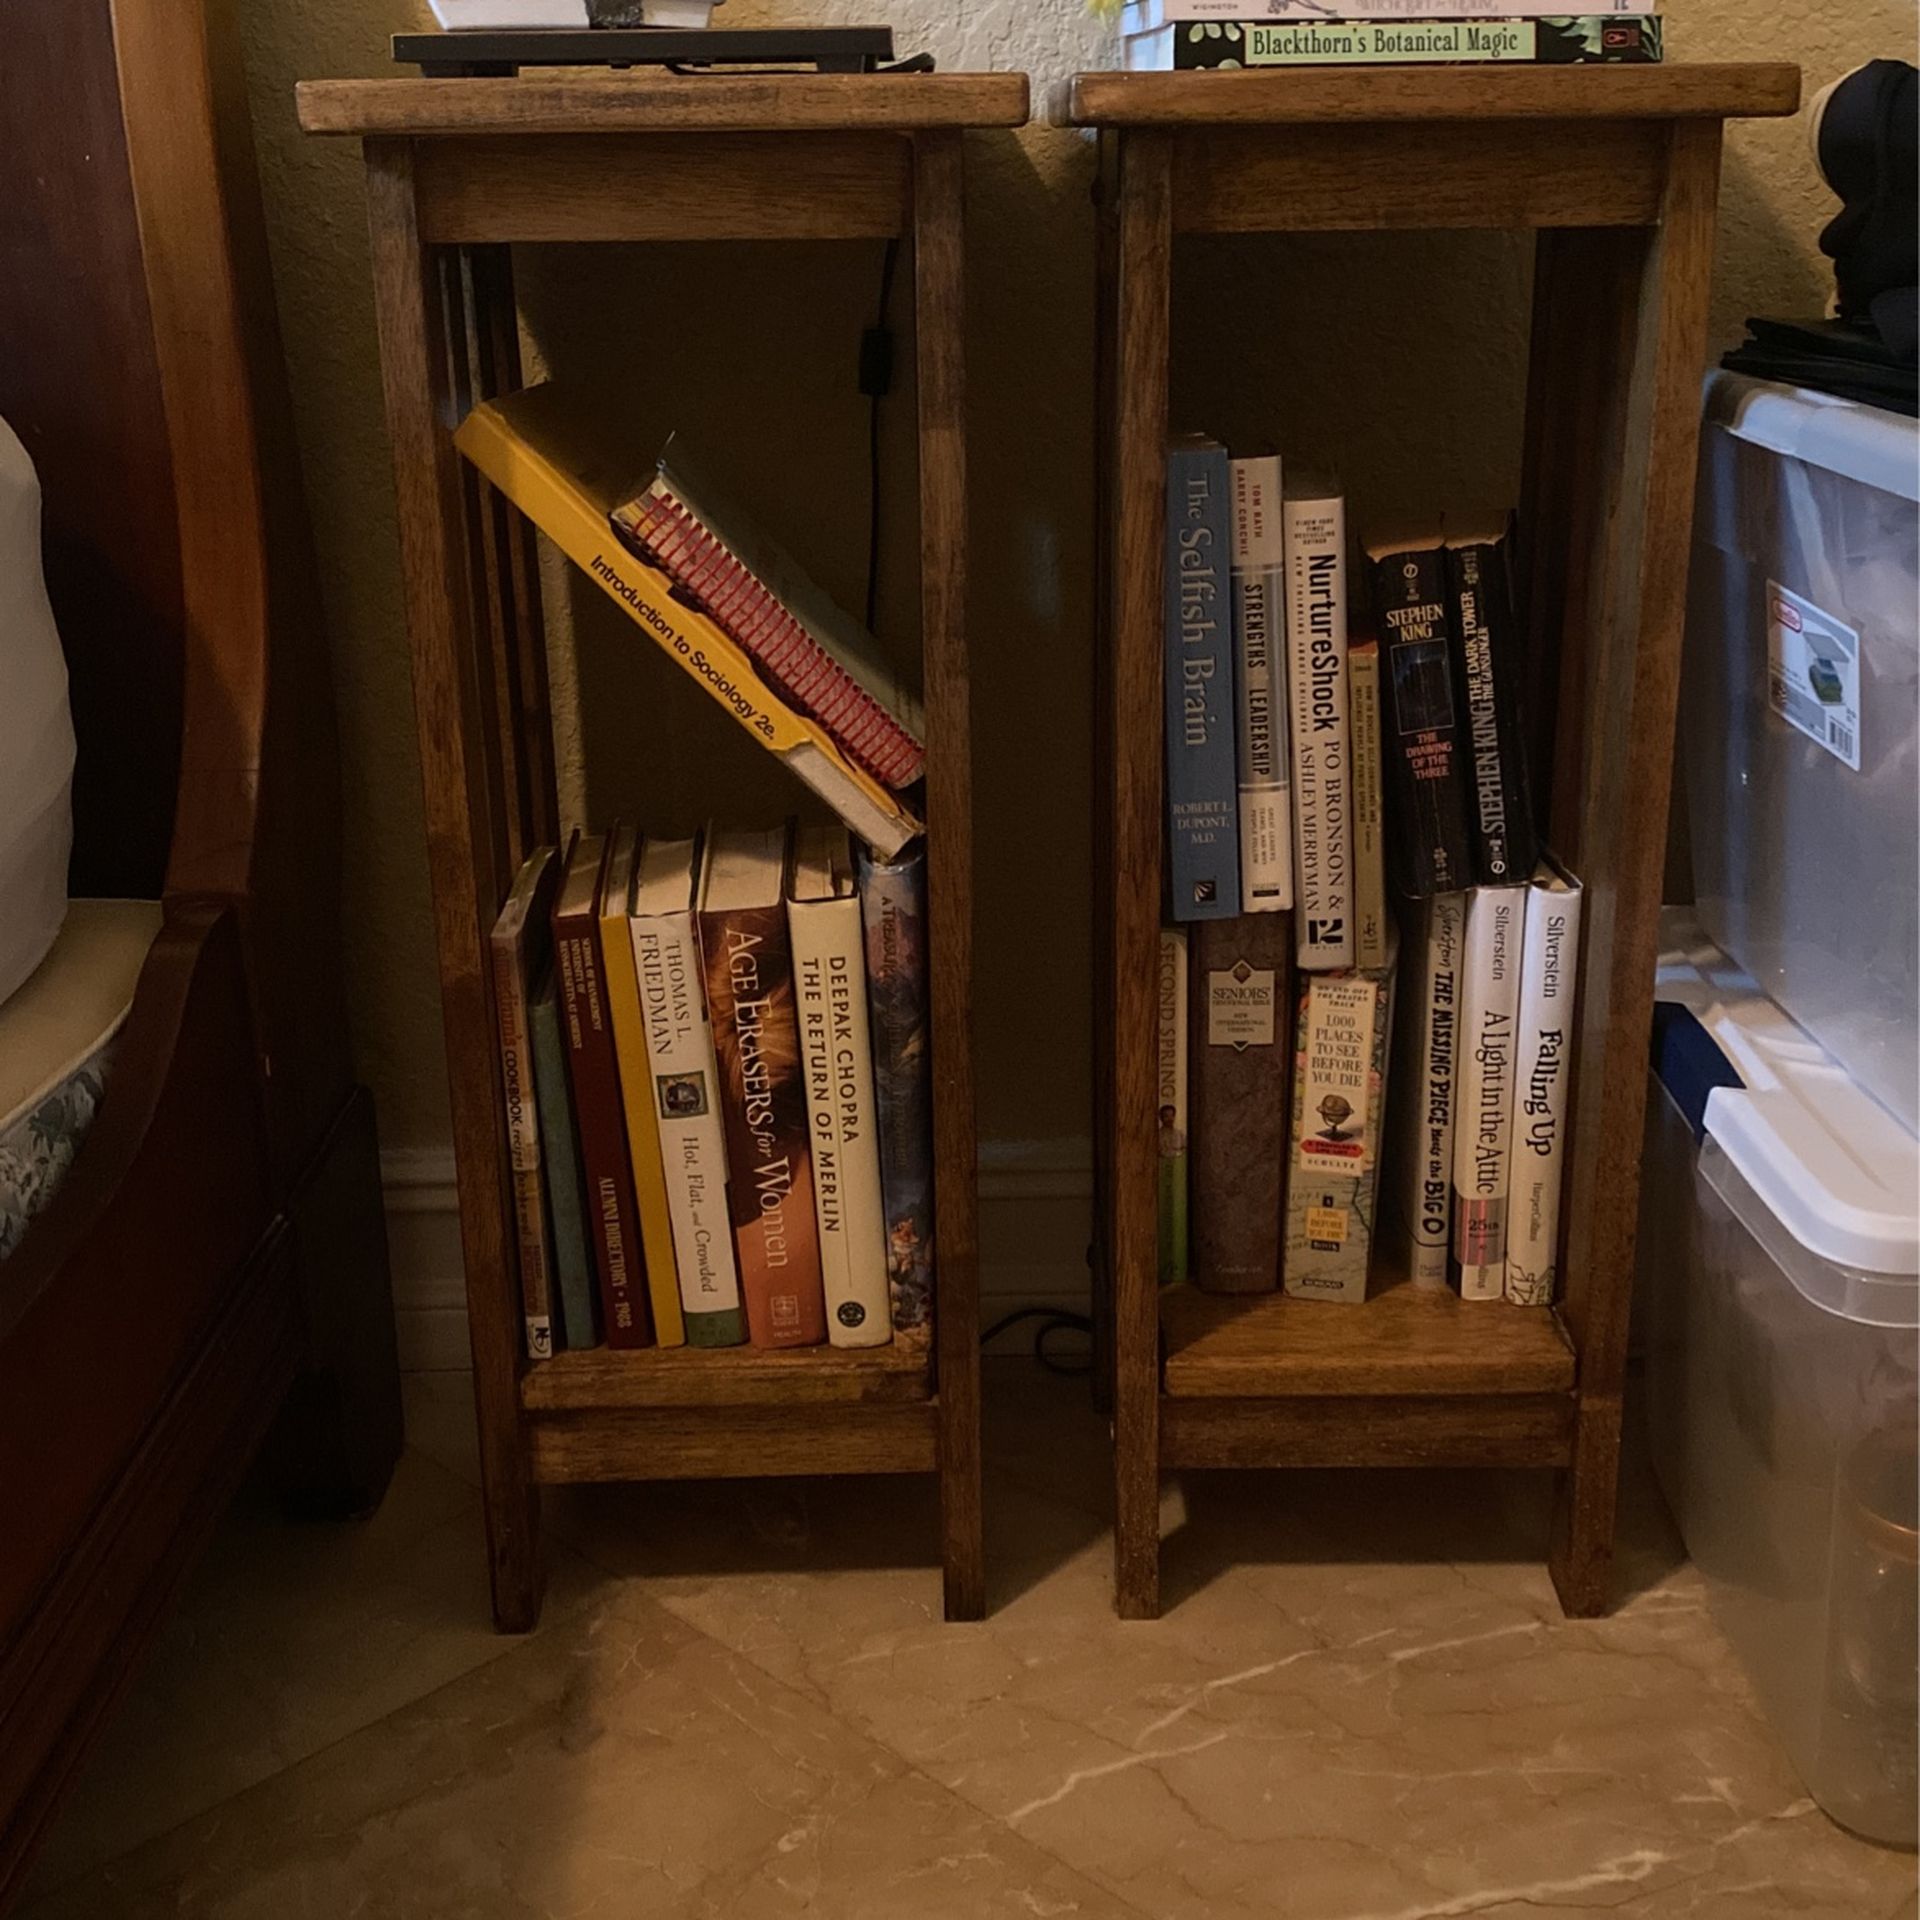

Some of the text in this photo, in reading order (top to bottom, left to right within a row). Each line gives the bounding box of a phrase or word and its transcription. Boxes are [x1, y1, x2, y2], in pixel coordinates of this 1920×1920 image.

[1252, 25, 1519, 57] Blackthorn's Botanical Magic
[1180, 473, 1217, 747] The Selfish Brain
[1385, 602, 1445, 628] STEPHEN
[1400, 621, 1433, 642] KING
[1460, 591, 1478, 638] TOWER
[590, 555, 776, 740] Introduction to Sociology 2e.
[1309, 554, 1340, 731] NurtureShock
[1464, 637, 1480, 675] DARK
[1245, 583, 1270, 776] STRENGTHS LEADERSHIP
[1467, 675, 1483, 703] THE
[1470, 702, 1499, 749] KING
[1474, 750, 1506, 834] STEPHEN
[1300, 742, 1320, 911] ASHLEY MERRYMAN
[1324, 740, 1345, 910] PO BRONSON &
[1437, 903, 1461, 968] Silverstein
[1492, 905, 1510, 980] Silverstein
[1543, 915, 1565, 999] Silverstein
[640, 933, 673, 1055] FRIEDMAN
[665, 941, 690, 1020] THOMAS
[1434, 971, 1454, 1005] THE
[829, 957, 859, 1143] DEEPAK CHOPRA
[1159, 942, 1176, 1098] SECOND SPRING
[1315, 1028, 1364, 1043] PLACES
[1315, 1042, 1360, 1058] TO SEE
[1430, 1007, 1453, 1076] MISSING
[802, 958, 840, 1232] THE RETURN OF MERLIN
[1311, 1057, 1363, 1072] BEFORE
[1312, 1070, 1362, 1087] YOU DIE
[1524, 1028, 1563, 1156] Falling Up
[725, 928, 793, 1269] AGE ERASERS for Women
[1428, 1079, 1451, 1126] PIECE
[1475, 1010, 1511, 1194] A Light in the Attic
[682, 1137, 700, 1170] Hot,
[1429, 1160, 1442, 1178] the
[599, 1177, 620, 1220] ALUMNI
[687, 1174, 706, 1208] Flat,
[1424, 1180, 1445, 1215] BIG
[604, 1220, 628, 1288] DIRECTORY
[1422, 1218, 1445, 1234] O
[695, 1230, 718, 1293] Crowded
